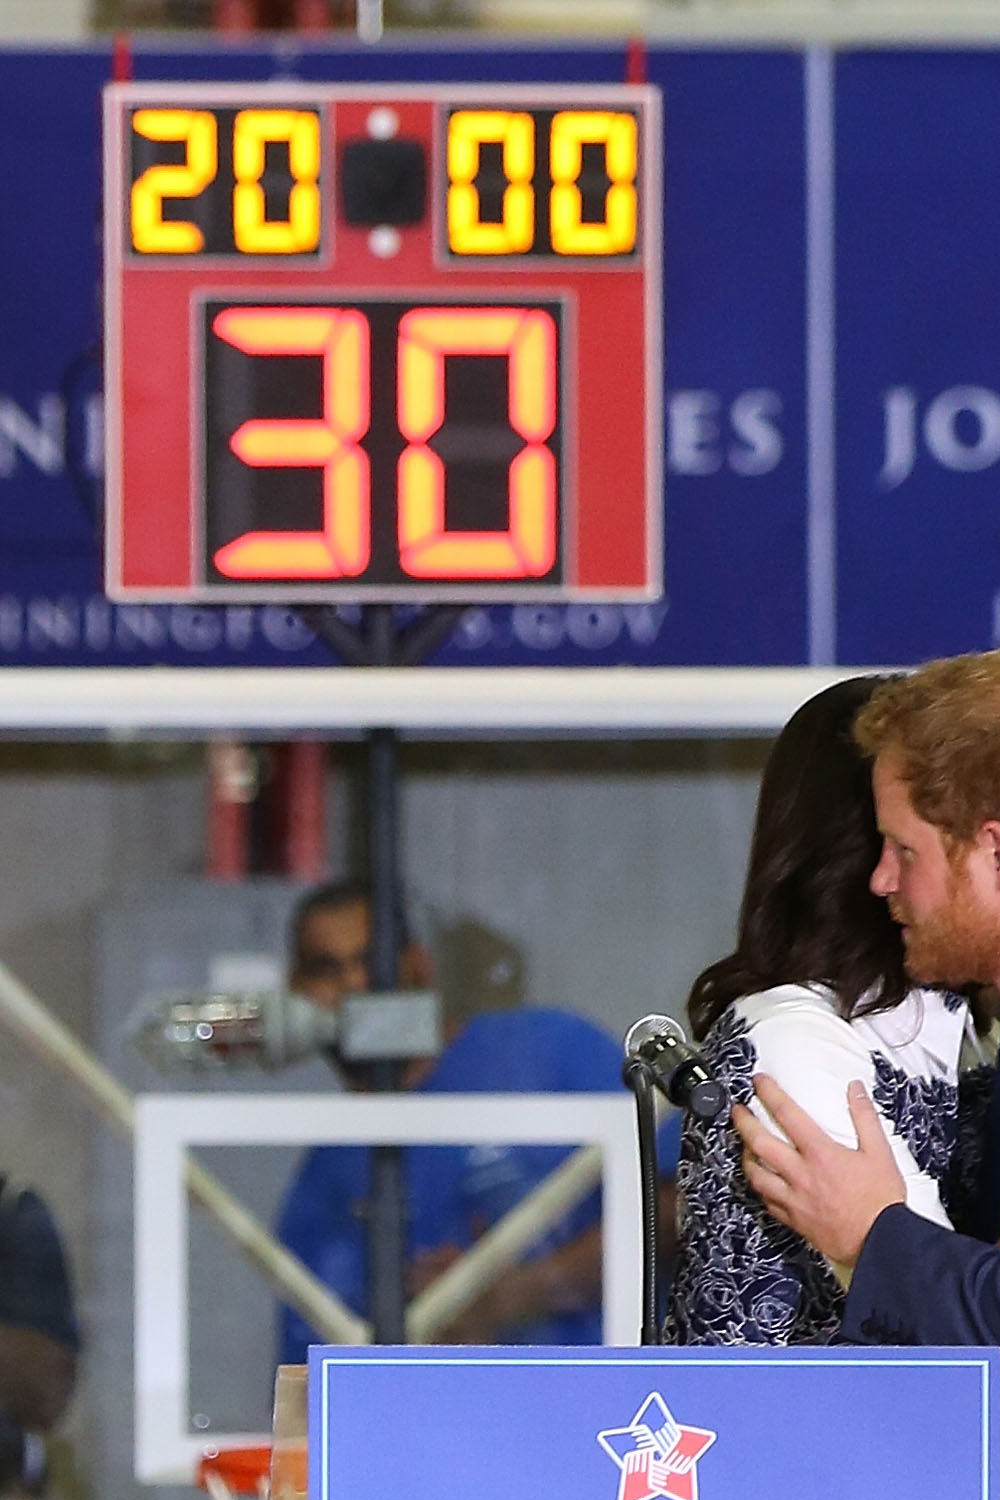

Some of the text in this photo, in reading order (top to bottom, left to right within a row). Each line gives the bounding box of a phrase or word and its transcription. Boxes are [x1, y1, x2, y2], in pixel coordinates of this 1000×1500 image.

[130, 108, 639, 255] 20 00
[212, 306, 557, 579] 30
